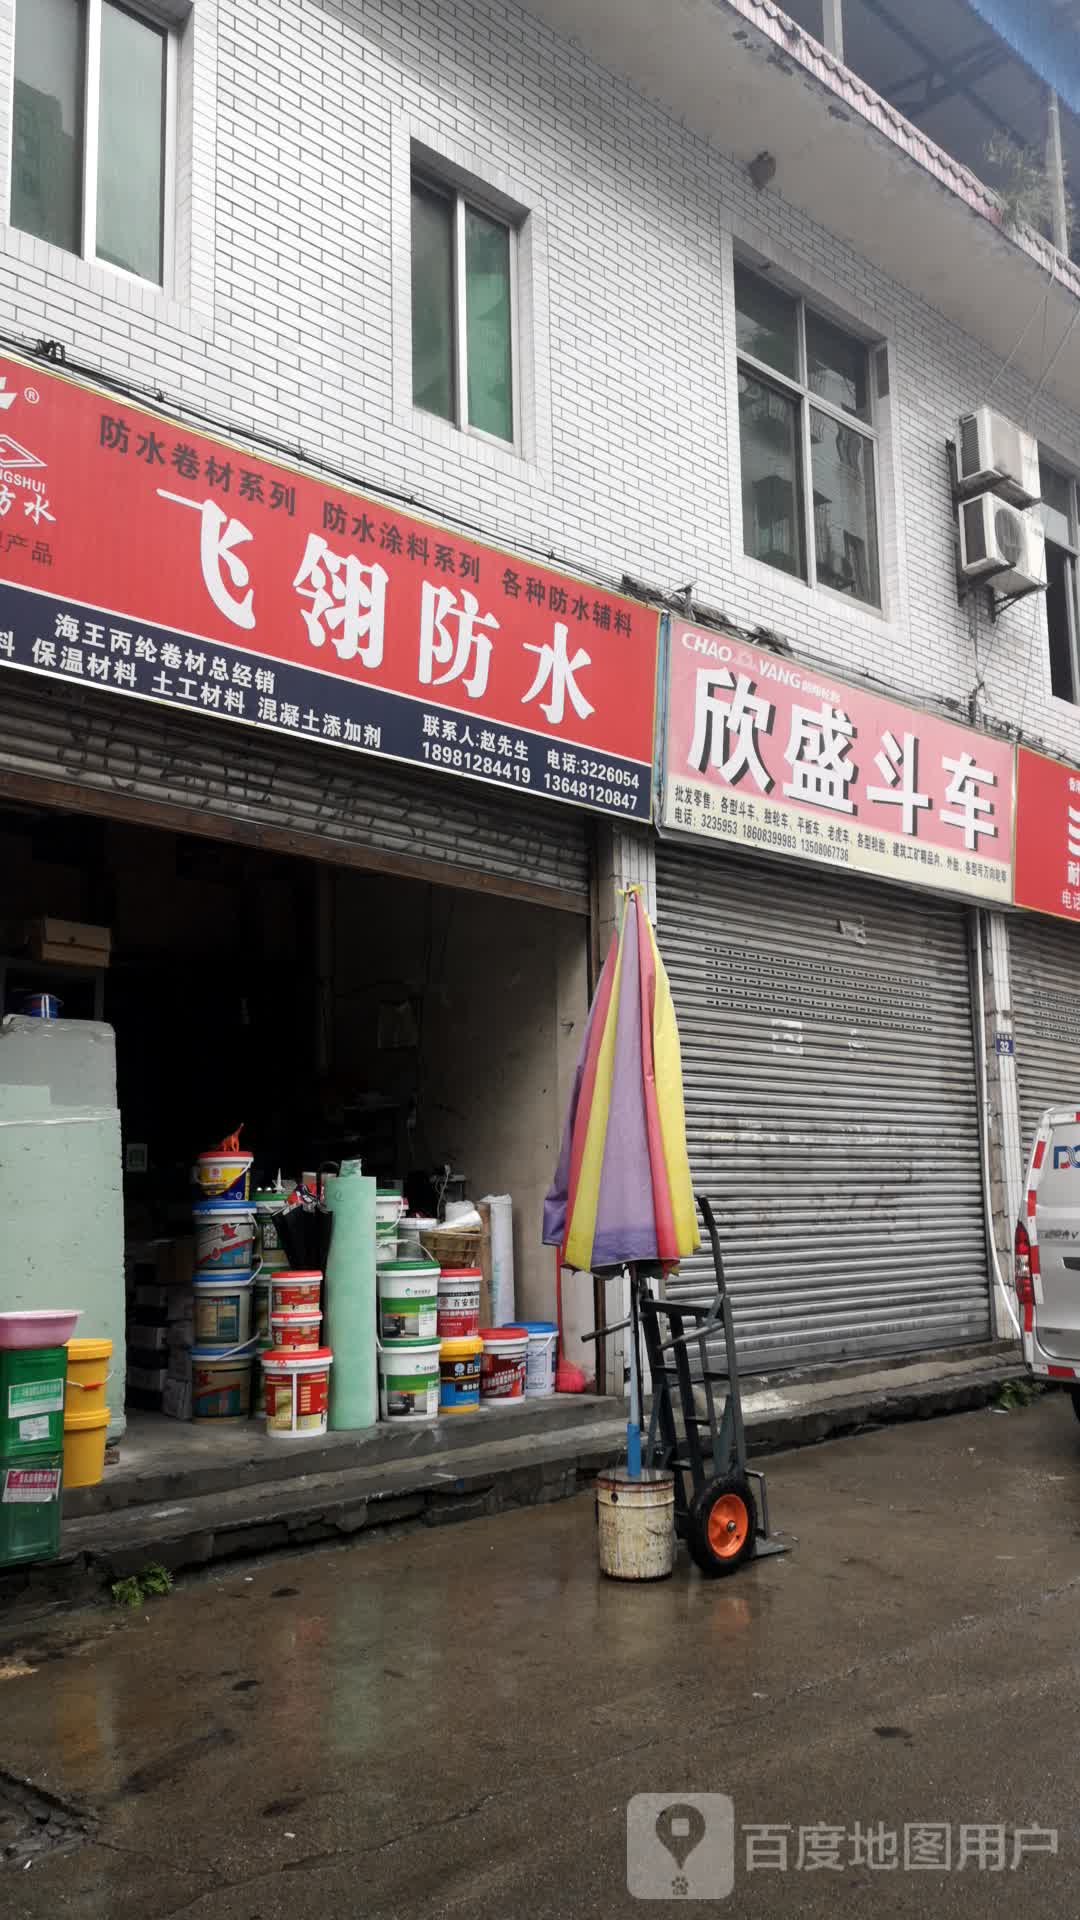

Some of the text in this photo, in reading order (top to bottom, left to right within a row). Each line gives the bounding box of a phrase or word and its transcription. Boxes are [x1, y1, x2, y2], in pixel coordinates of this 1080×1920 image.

[100, 416, 632, 637] 防水卷材系列 防水涂料系列 各种防水辅料
[54, 612, 275, 695] 海王丙纶卷材总经销
[156, 488, 595, 724] 飞翎防水
[681, 632, 732, 663] CHAO
[32, 638, 137, 688] 保温材料
[151, 671, 245, 715] 土工材料
[258, 697, 381, 749] 混凝土添加剂
[422, 741, 638, 810] 18981284419 13648120847
[687, 667, 996, 850] 欣盛斗车
[999, 1040, 1010, 1053] 32
